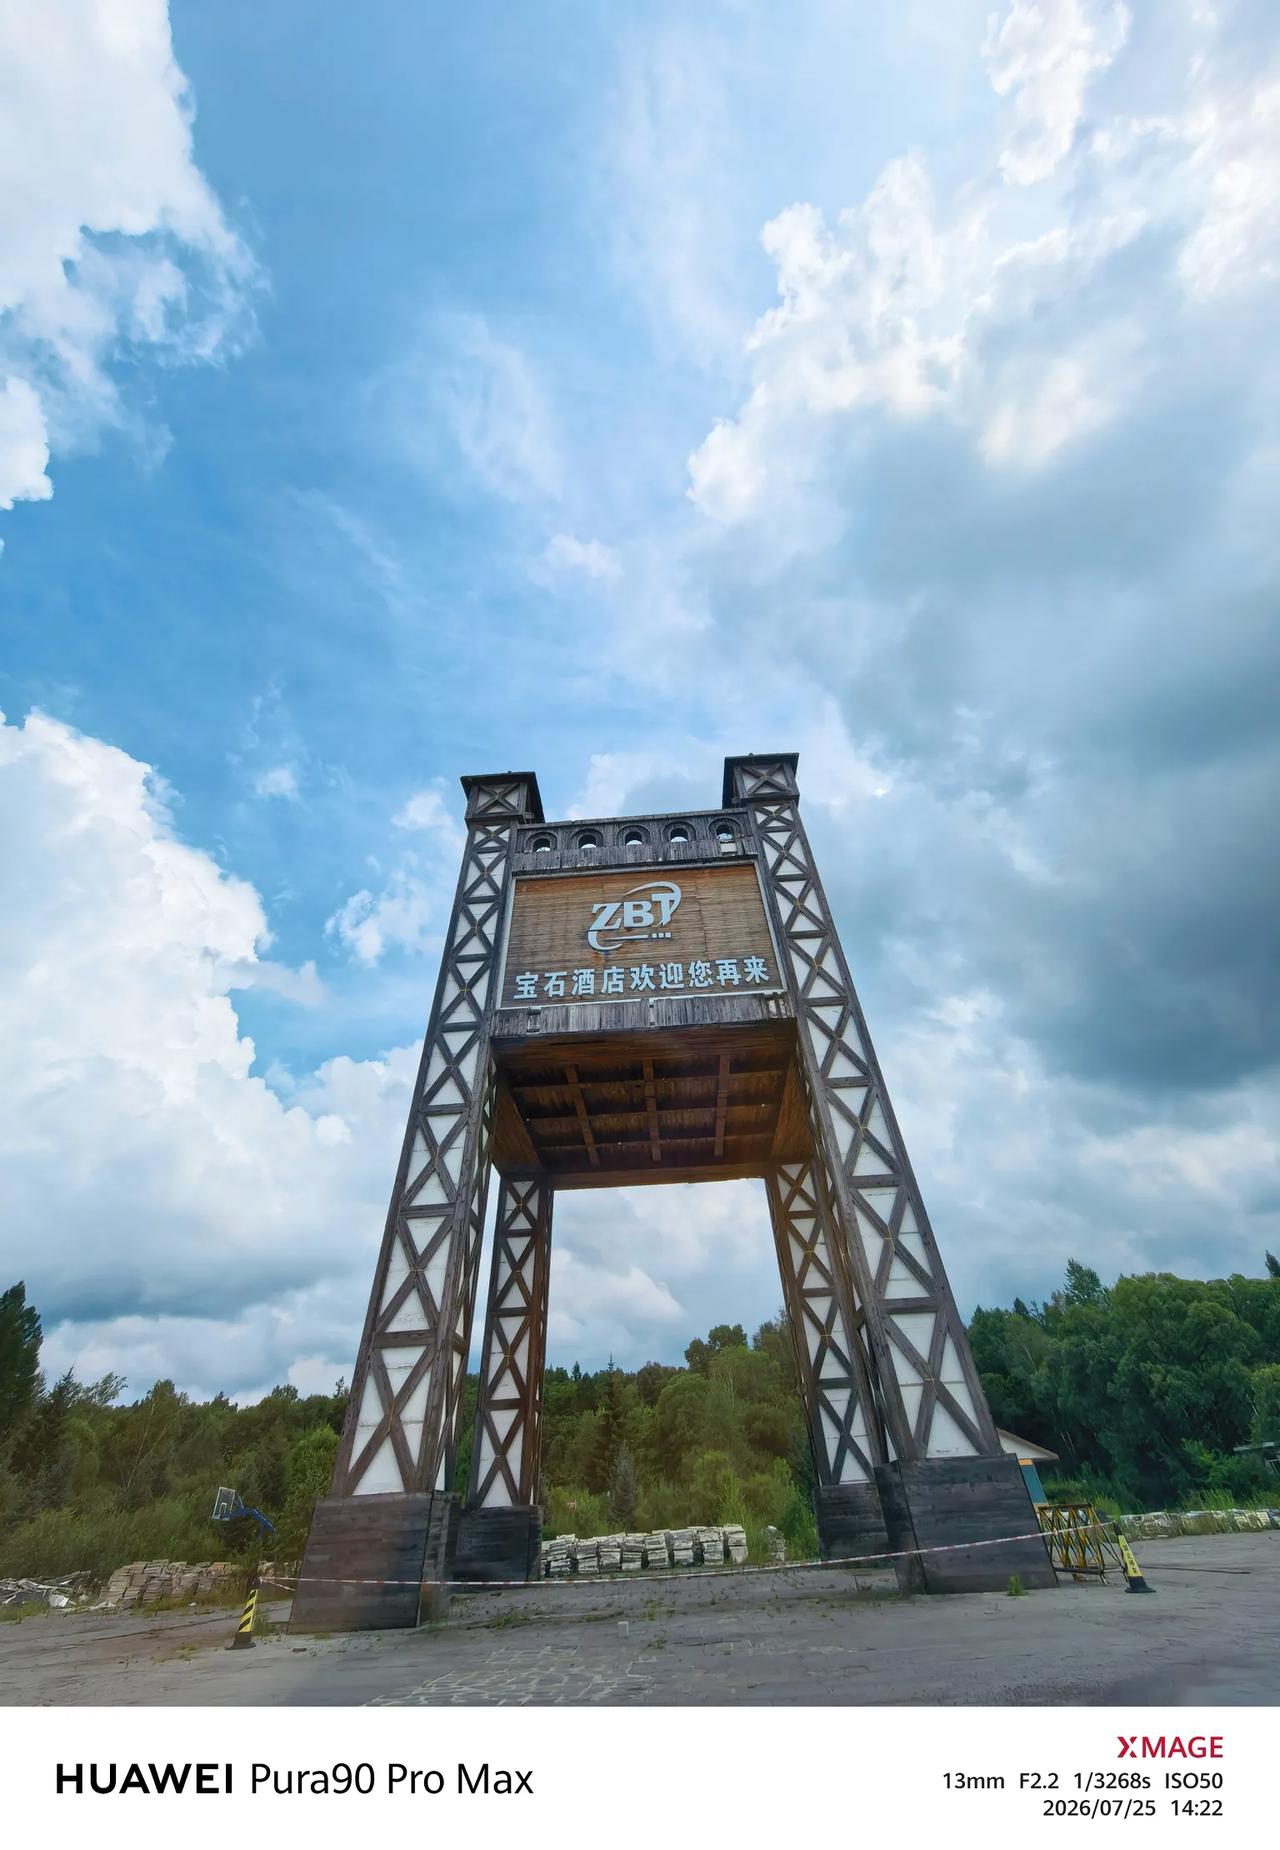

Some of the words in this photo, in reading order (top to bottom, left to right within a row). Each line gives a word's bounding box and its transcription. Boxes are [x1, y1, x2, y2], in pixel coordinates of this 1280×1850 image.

[589, 892, 680, 931] ZBT
[513, 955, 770, 999] 宝石酒店欢迎您再来
